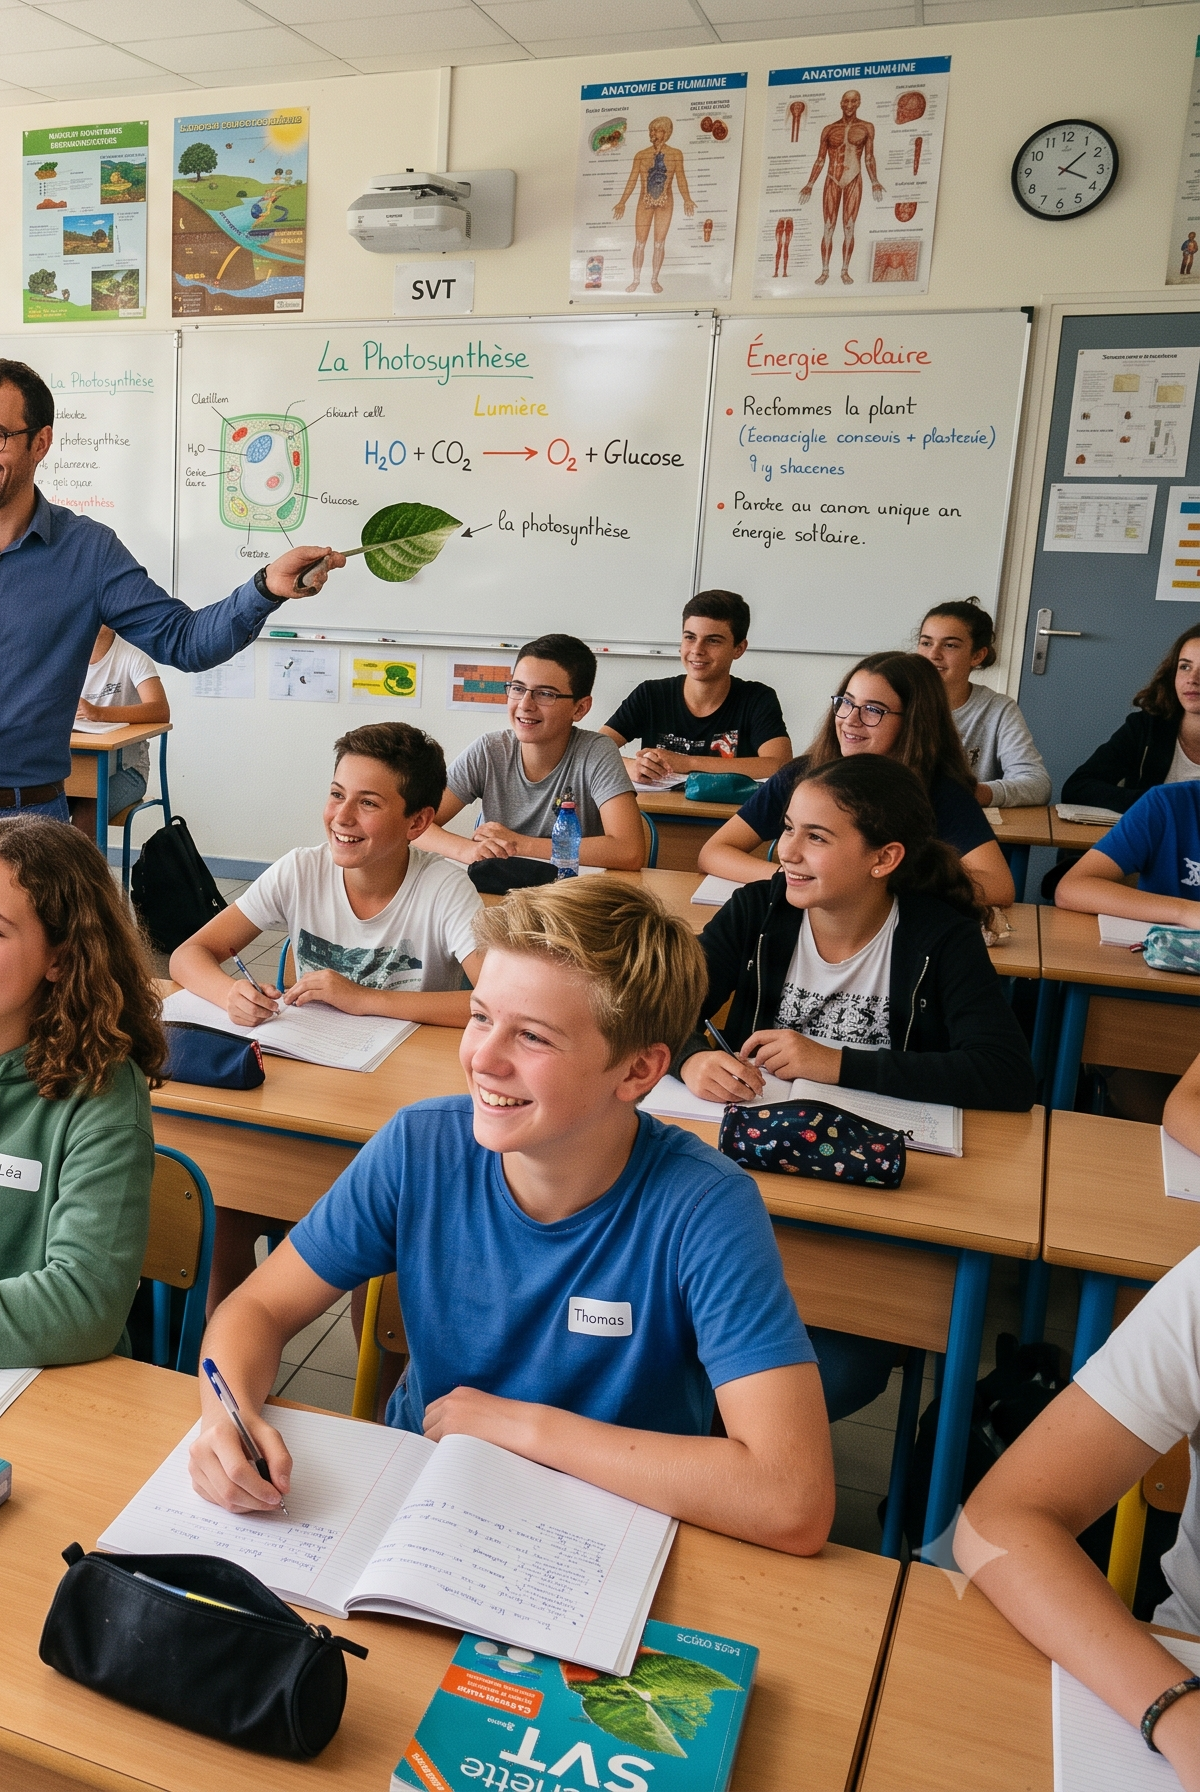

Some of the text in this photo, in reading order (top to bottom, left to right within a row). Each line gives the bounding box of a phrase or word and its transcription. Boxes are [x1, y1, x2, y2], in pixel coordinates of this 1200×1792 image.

[802, 67, 860, 80] ANATOMIE
[601, 82, 656, 96] ANATOMIE
[660, 81, 675, 92] DE
[1046, 138, 1056, 148] 11
[1062, 132, 1075, 142] 12
[1032, 150, 1044, 161] 10
[1094, 147, 1102, 158] 2
[1024, 168, 1032, 178] 9
[1096, 164, 1104, 174] 3
[1028, 184, 1036, 194] 8
[1088, 180, 1096, 190] 4
[1040, 195, 1048, 206] 7
[1056, 198, 1064, 209] 6
[1074, 193, 1082, 204] 5
[411, 279, 456, 300] SVT
[318, 340, 530, 386] La Photosynthèse
[747, 333, 932, 380] Énergie Solaire
[50, 370, 154, 396] La Photosynthèse
[473, 394, 549, 417] Lumière
[845, 394, 860, 416] la
[869, 395, 918, 424] plant
[604, 438, 684, 467] Glucose
[320, 492, 359, 506] Glucose
[792, 502, 811, 512] au
[820, 504, 870, 514] canon
[878, 504, 930, 524] unique
[938, 506, 962, 518] an
[498, 510, 631, 546] la photosynthèse
[732, 520, 786, 548] énergie
[574, 1308, 624, 1326] Thomas
[499, 1726, 656, 1792] SVT
